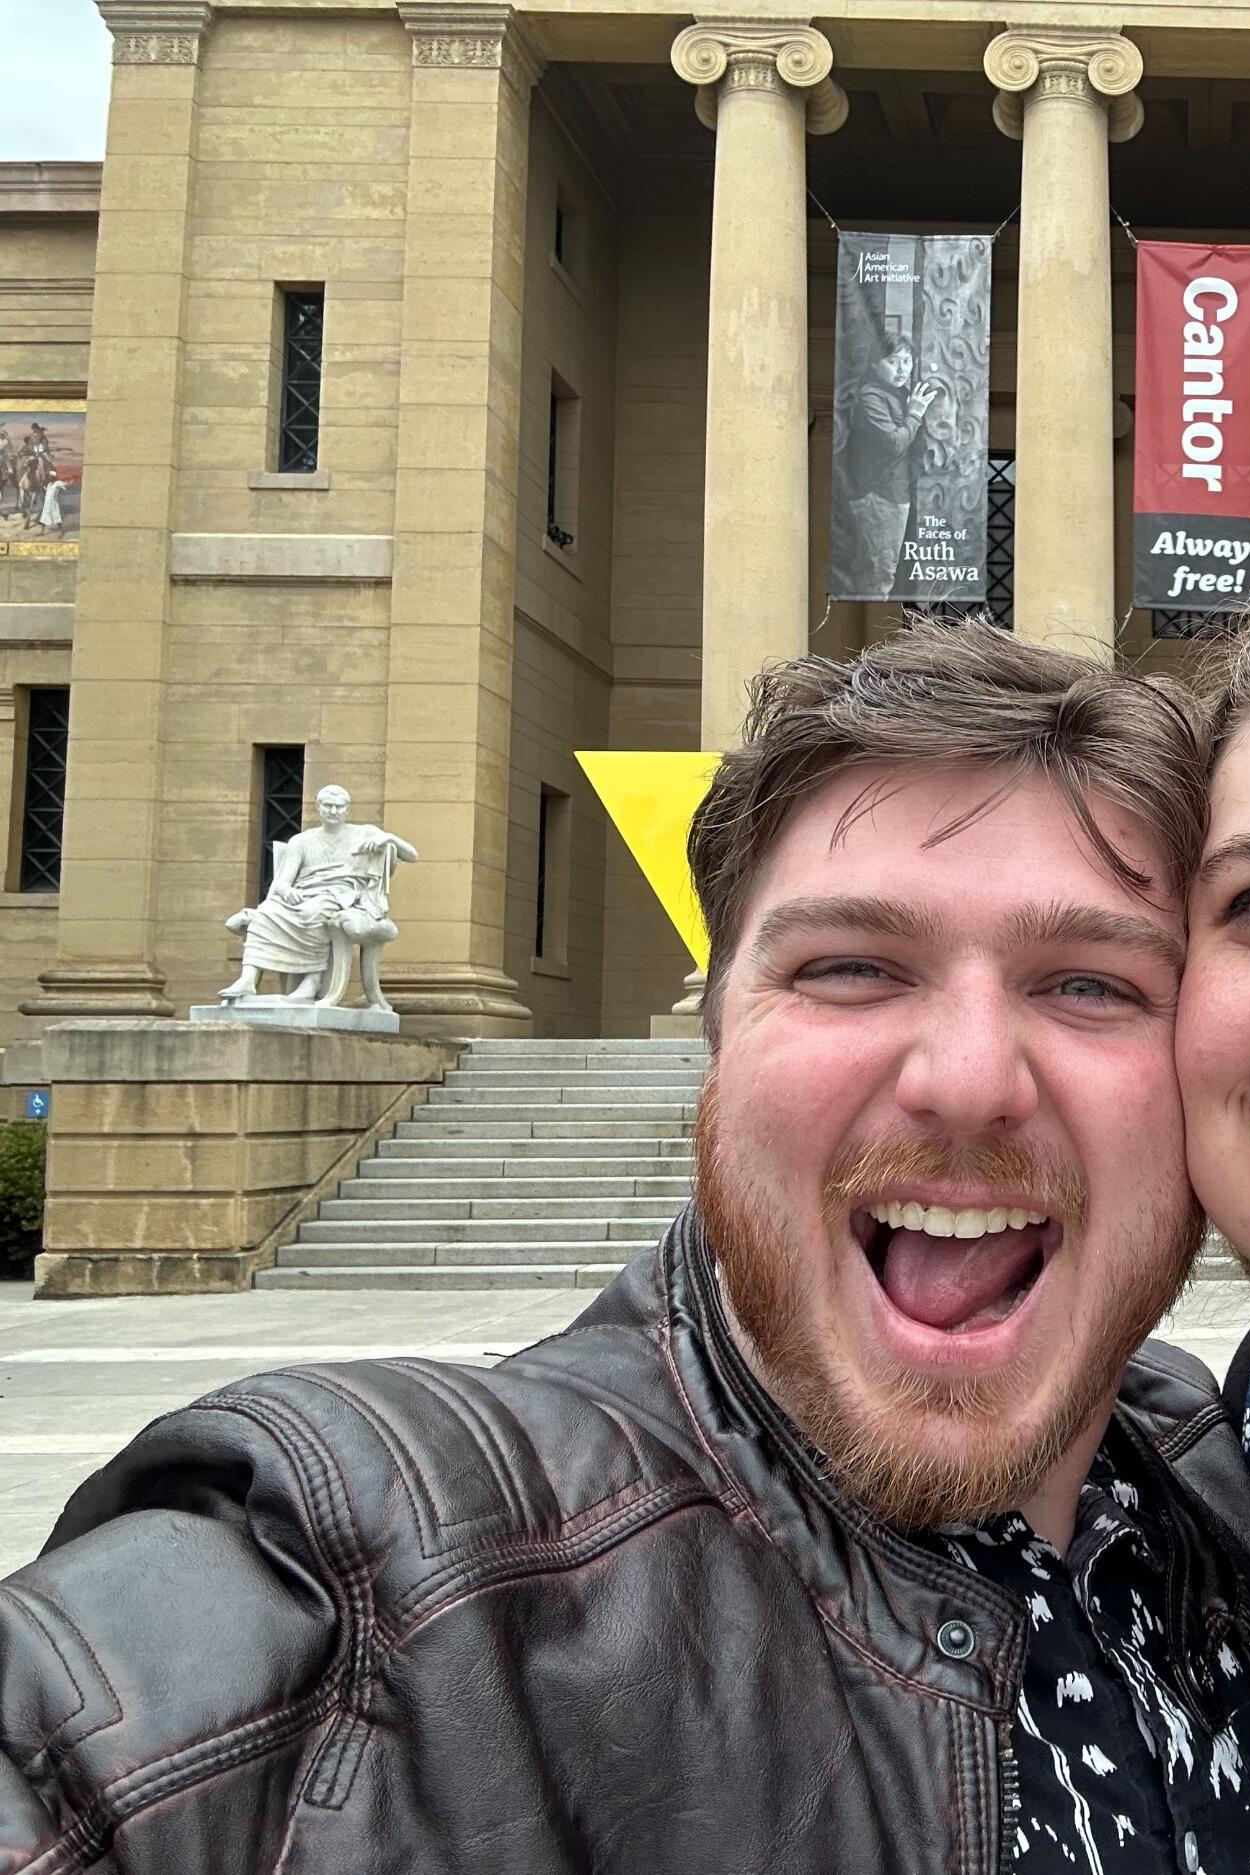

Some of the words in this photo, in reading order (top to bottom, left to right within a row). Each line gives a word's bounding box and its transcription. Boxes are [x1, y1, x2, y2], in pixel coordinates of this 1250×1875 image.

[865, 252, 890, 261] Asian
[864, 262, 909, 272] American
[864, 273, 880, 283] Art
[881, 273, 920, 283] Initiative
[1182, 276, 1239, 492] Cantor
[924, 515, 947, 527] The
[918, 528, 951, 540] Faces
[954, 529, 967, 540] of
[904, 541, 955, 561] Ruth
[909, 561, 980, 581] Asawa
[1168, 566, 1246, 597] free!
